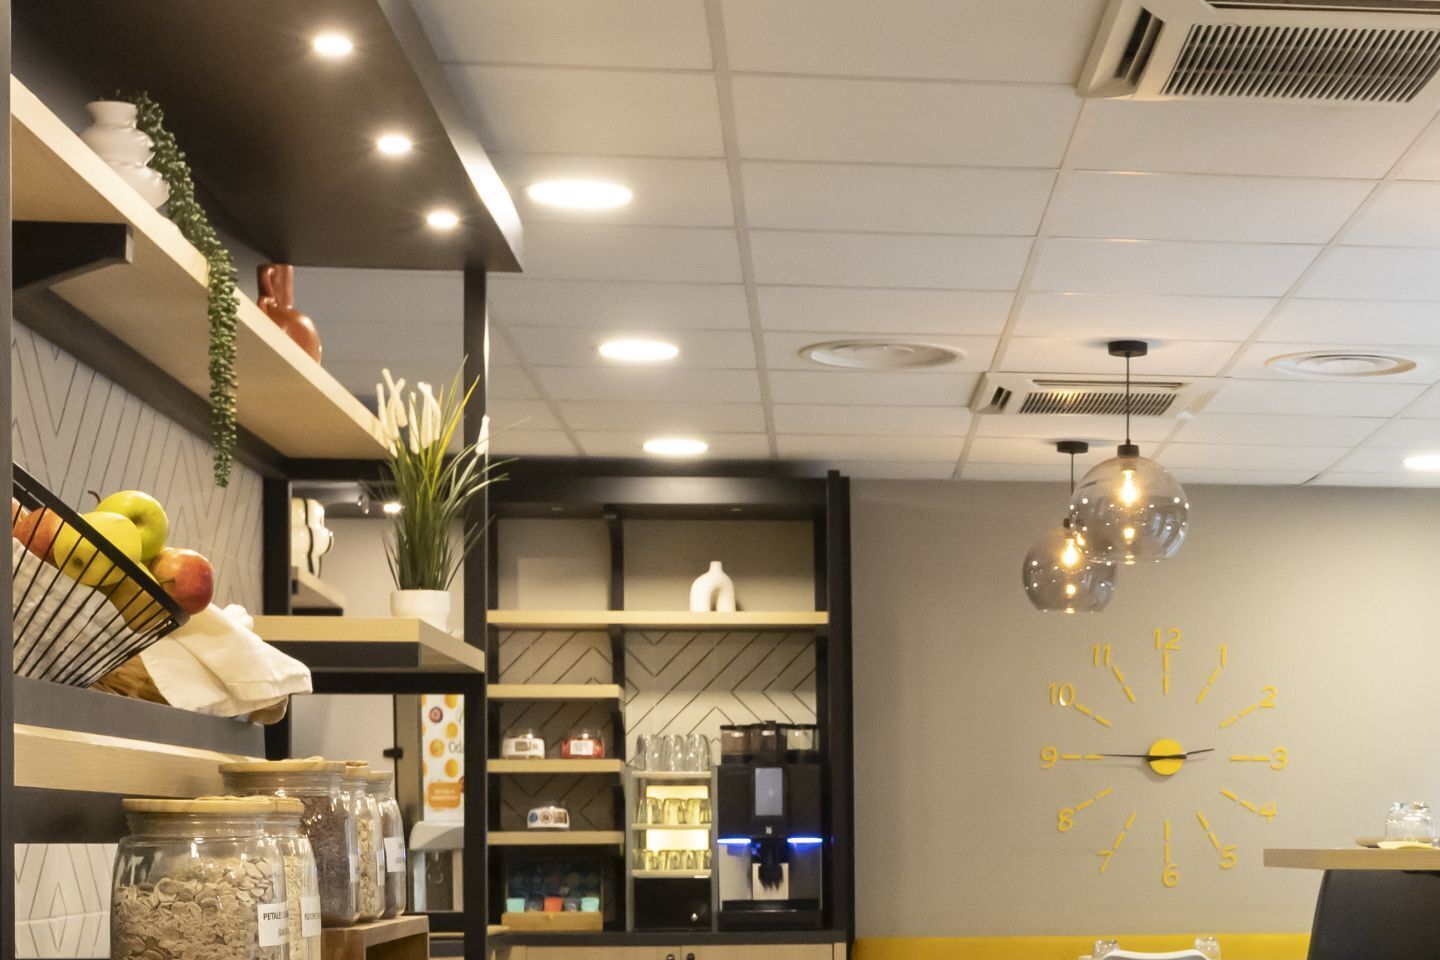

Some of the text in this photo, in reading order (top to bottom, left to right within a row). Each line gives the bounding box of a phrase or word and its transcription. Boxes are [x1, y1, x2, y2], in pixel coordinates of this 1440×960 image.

[1154, 628, 1182, 650] 12
[1092, 643, 1111, 667] 11
[1219, 643, 1227, 667] 1
[1048, 682, 1075, 706] 10
[1259, 685, 1278, 708] 2
[1040, 746, 1058, 768] 9
[1270, 746, 1288, 770] 3
[1057, 808, 1074, 832] 8
[1259, 802, 1278, 823] 4
[1096, 850, 1114, 873] 7
[1219, 844, 1237, 868] 5
[1162, 863, 1180, 887] 6
